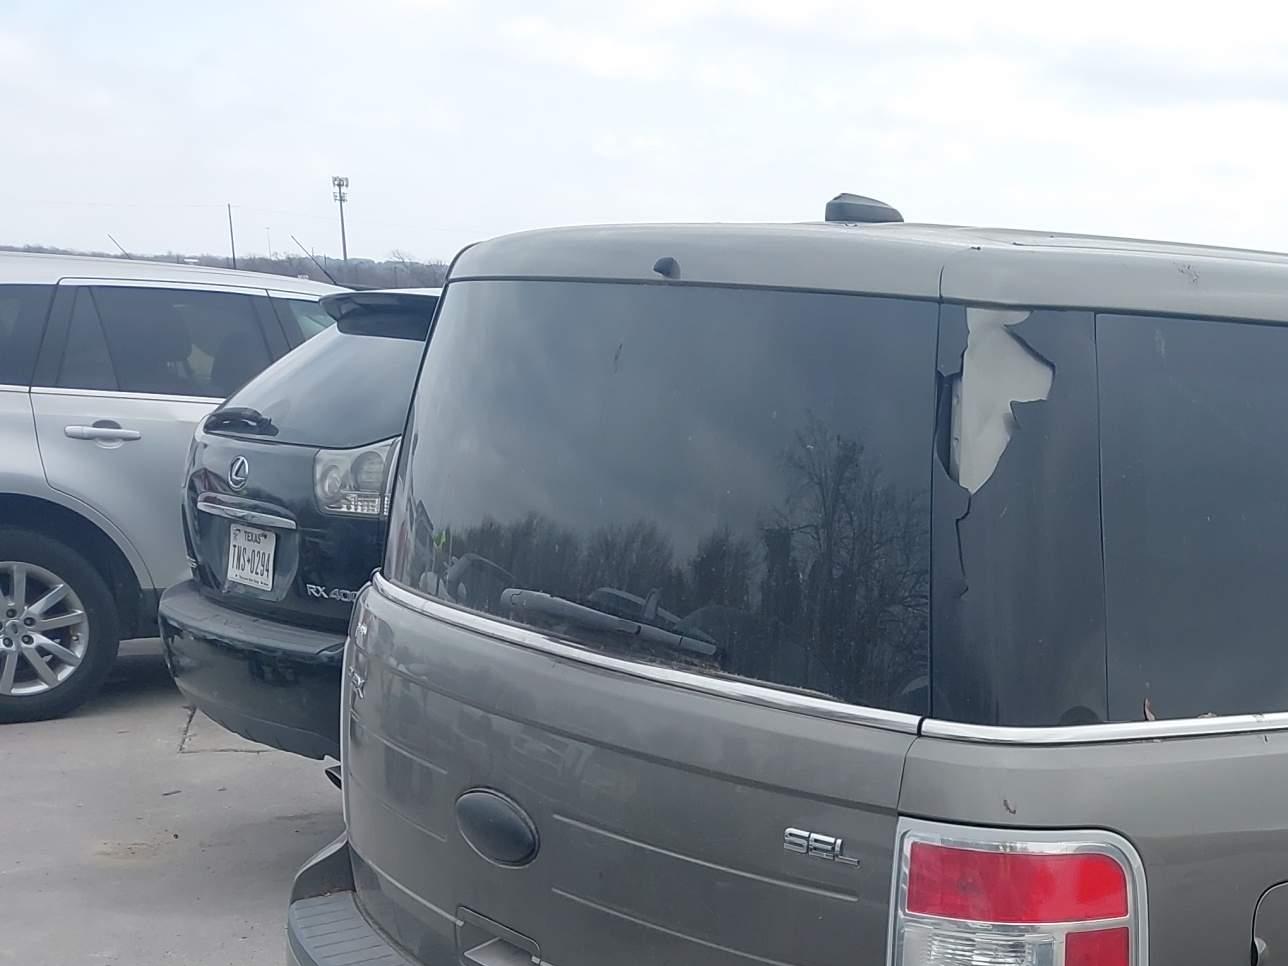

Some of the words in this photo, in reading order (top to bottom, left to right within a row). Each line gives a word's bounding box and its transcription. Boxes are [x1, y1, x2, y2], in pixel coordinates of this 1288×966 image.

[243, 530, 262, 545] TEXAS
[306, 583, 329, 599] RX
[783, 827, 860, 866] SEL
